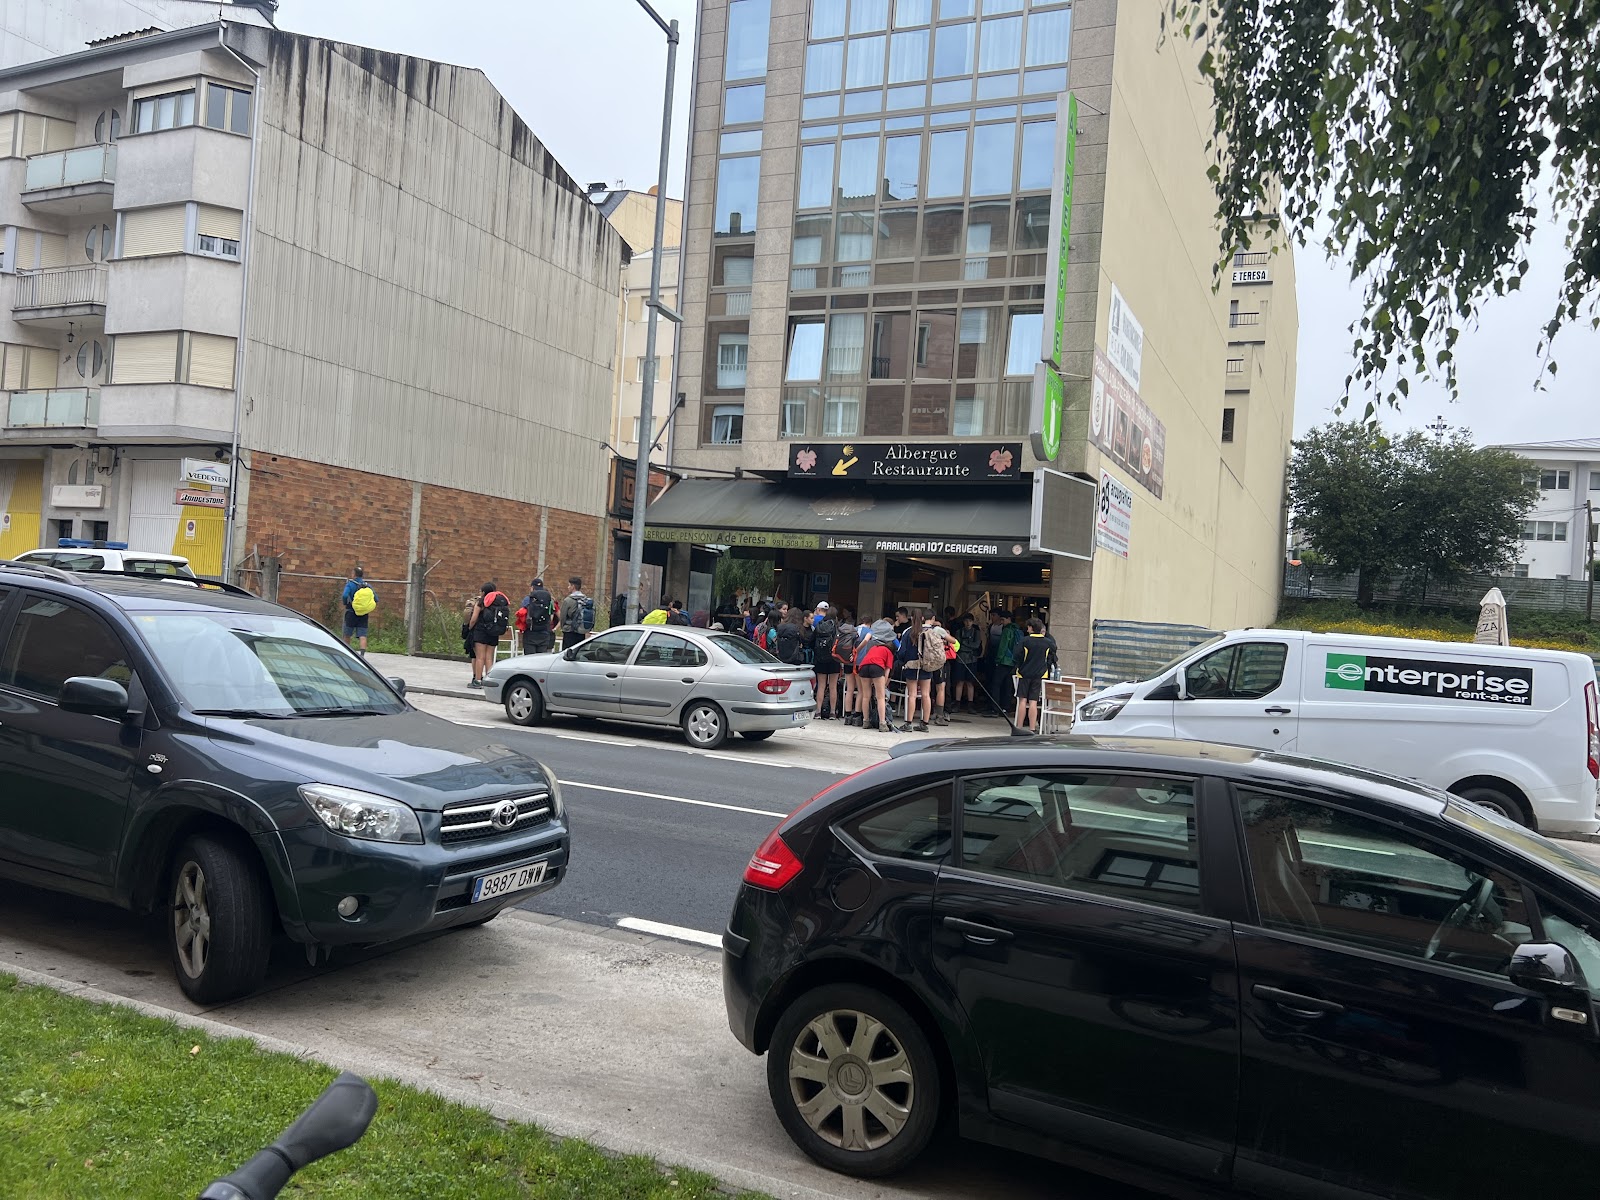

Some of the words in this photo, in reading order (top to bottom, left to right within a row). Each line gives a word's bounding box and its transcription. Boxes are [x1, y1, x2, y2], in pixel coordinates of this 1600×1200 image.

[1239, 270, 1266, 281] TERESA
[885, 445, 958, 464] Albergue
[872, 461, 970, 477] Restaurante
[188, 471, 229, 483] VREDESTEIN
[181, 493, 225, 504] BRIDGESTONE
[644, 530, 675, 540] LBERGUE
[680, 530, 713, 541] PENSIÓN
[725, 533, 737, 543] de
[738, 533, 767, 545] Teresa
[801, 540, 813, 548] 132
[876, 541, 926, 552] PARRILLADA
[927, 541, 944, 553] 107
[945, 543, 998, 555] CERVECERIA
[1336, 662, 1530, 693] enterprise
[1455, 689, 1529, 704] rent-a-car
[518, 865, 544, 887] DWW
